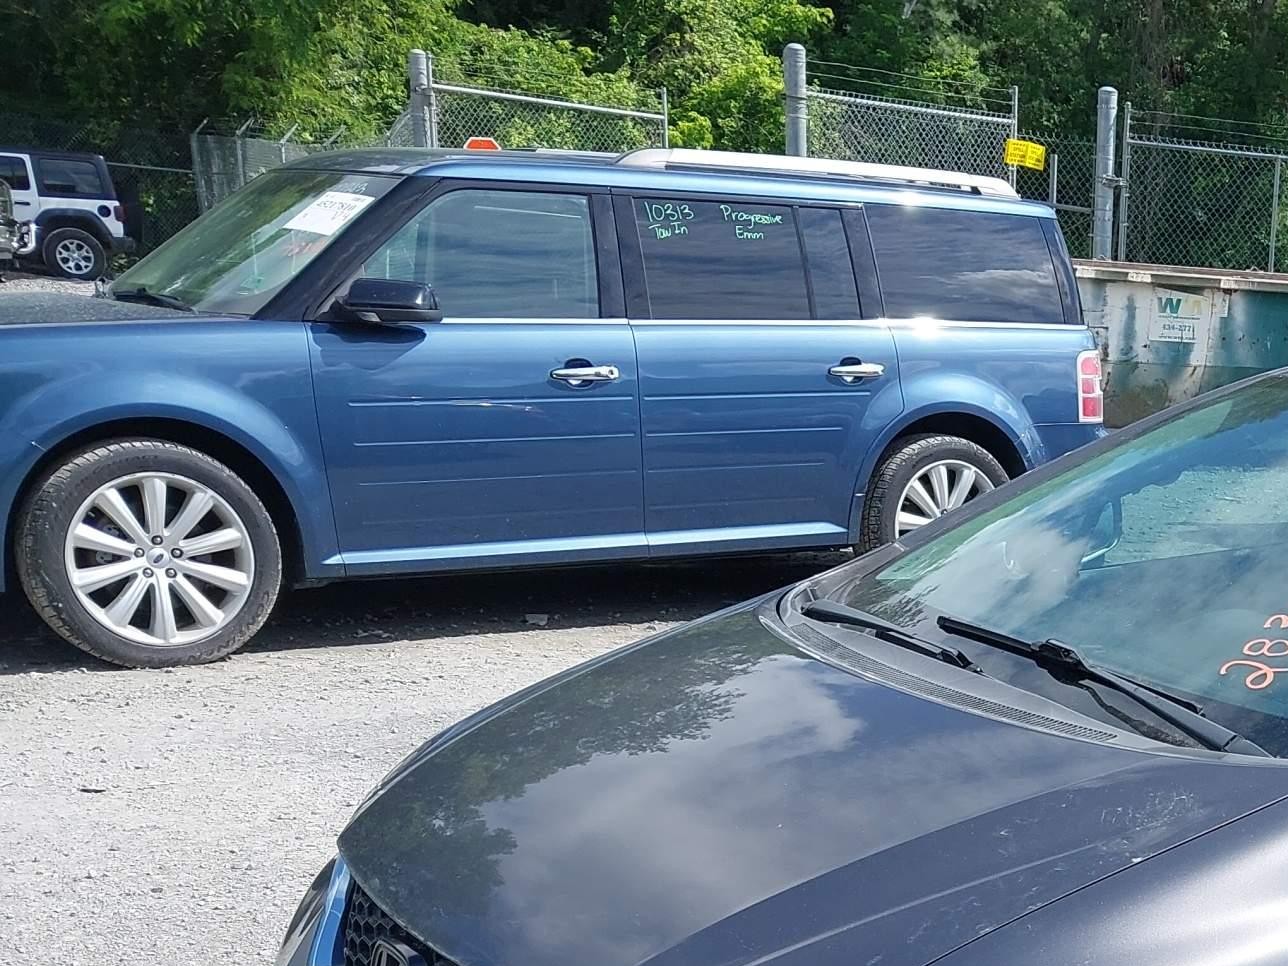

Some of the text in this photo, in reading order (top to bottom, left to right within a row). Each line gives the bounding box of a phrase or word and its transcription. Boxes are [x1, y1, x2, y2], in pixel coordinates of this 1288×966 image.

[644, 201, 695, 223] 10313
[719, 204, 783, 229] Progressive
[670, 222, 689, 235] In
